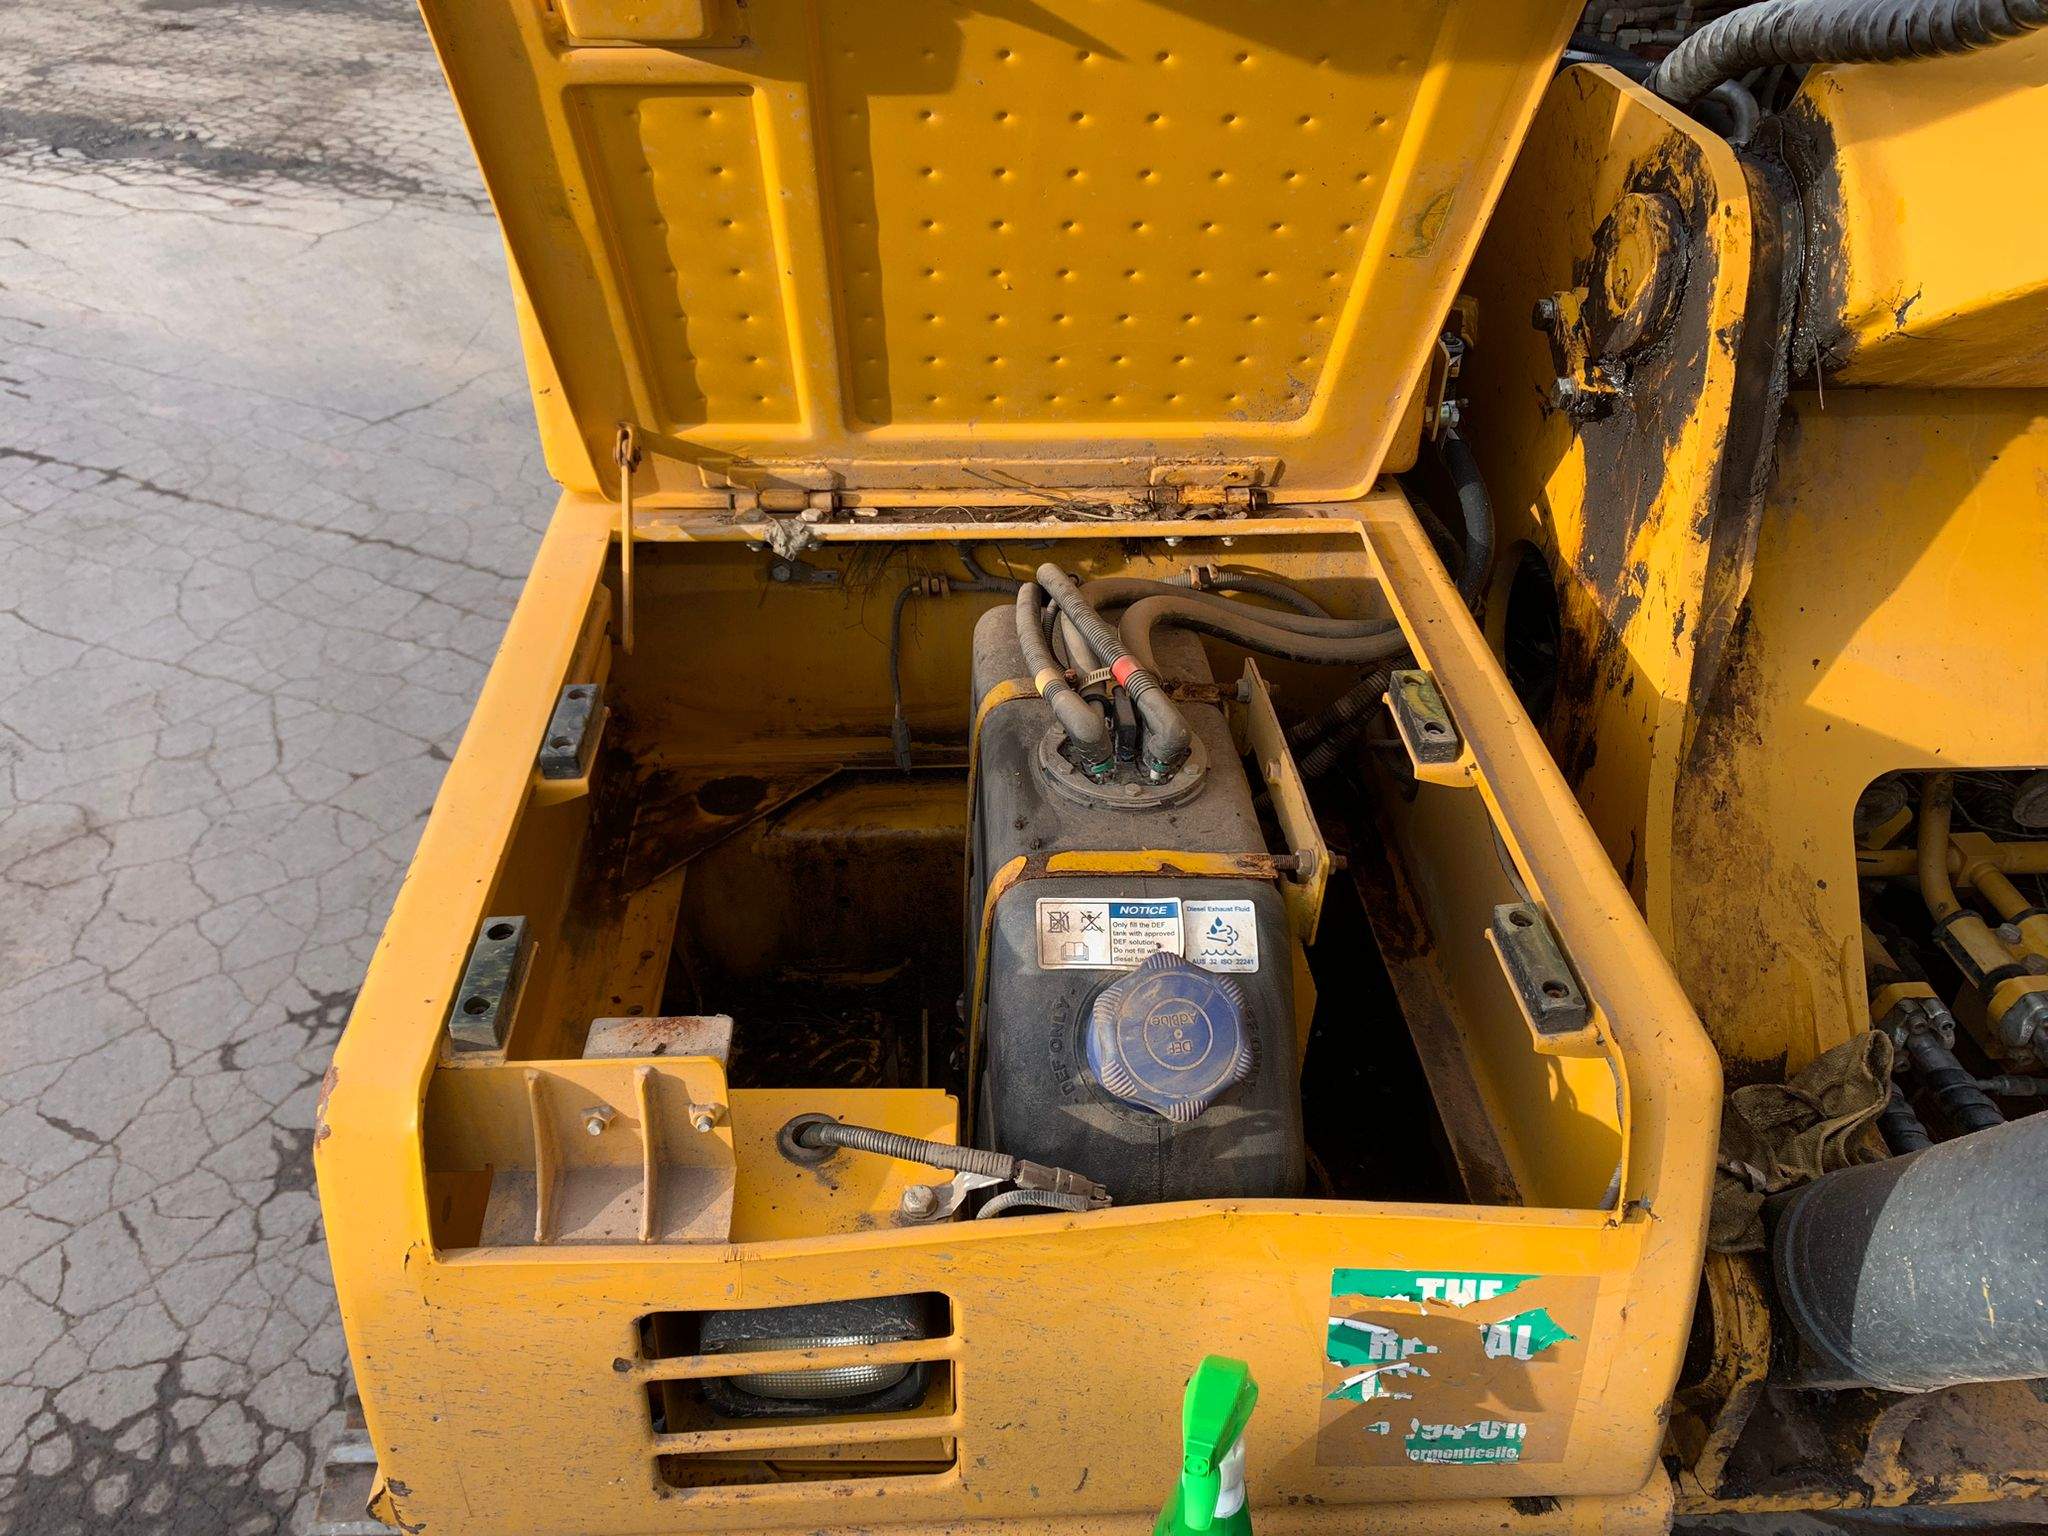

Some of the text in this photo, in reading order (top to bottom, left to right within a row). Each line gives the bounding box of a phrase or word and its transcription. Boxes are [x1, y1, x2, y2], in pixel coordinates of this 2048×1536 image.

[1120, 906, 1167, 915] NOTICE
[1151, 1012, 1198, 1026] AdBlue
[1049, 996, 1075, 1096] DEF ONLY
[1169, 1040, 1193, 1053] DEF
